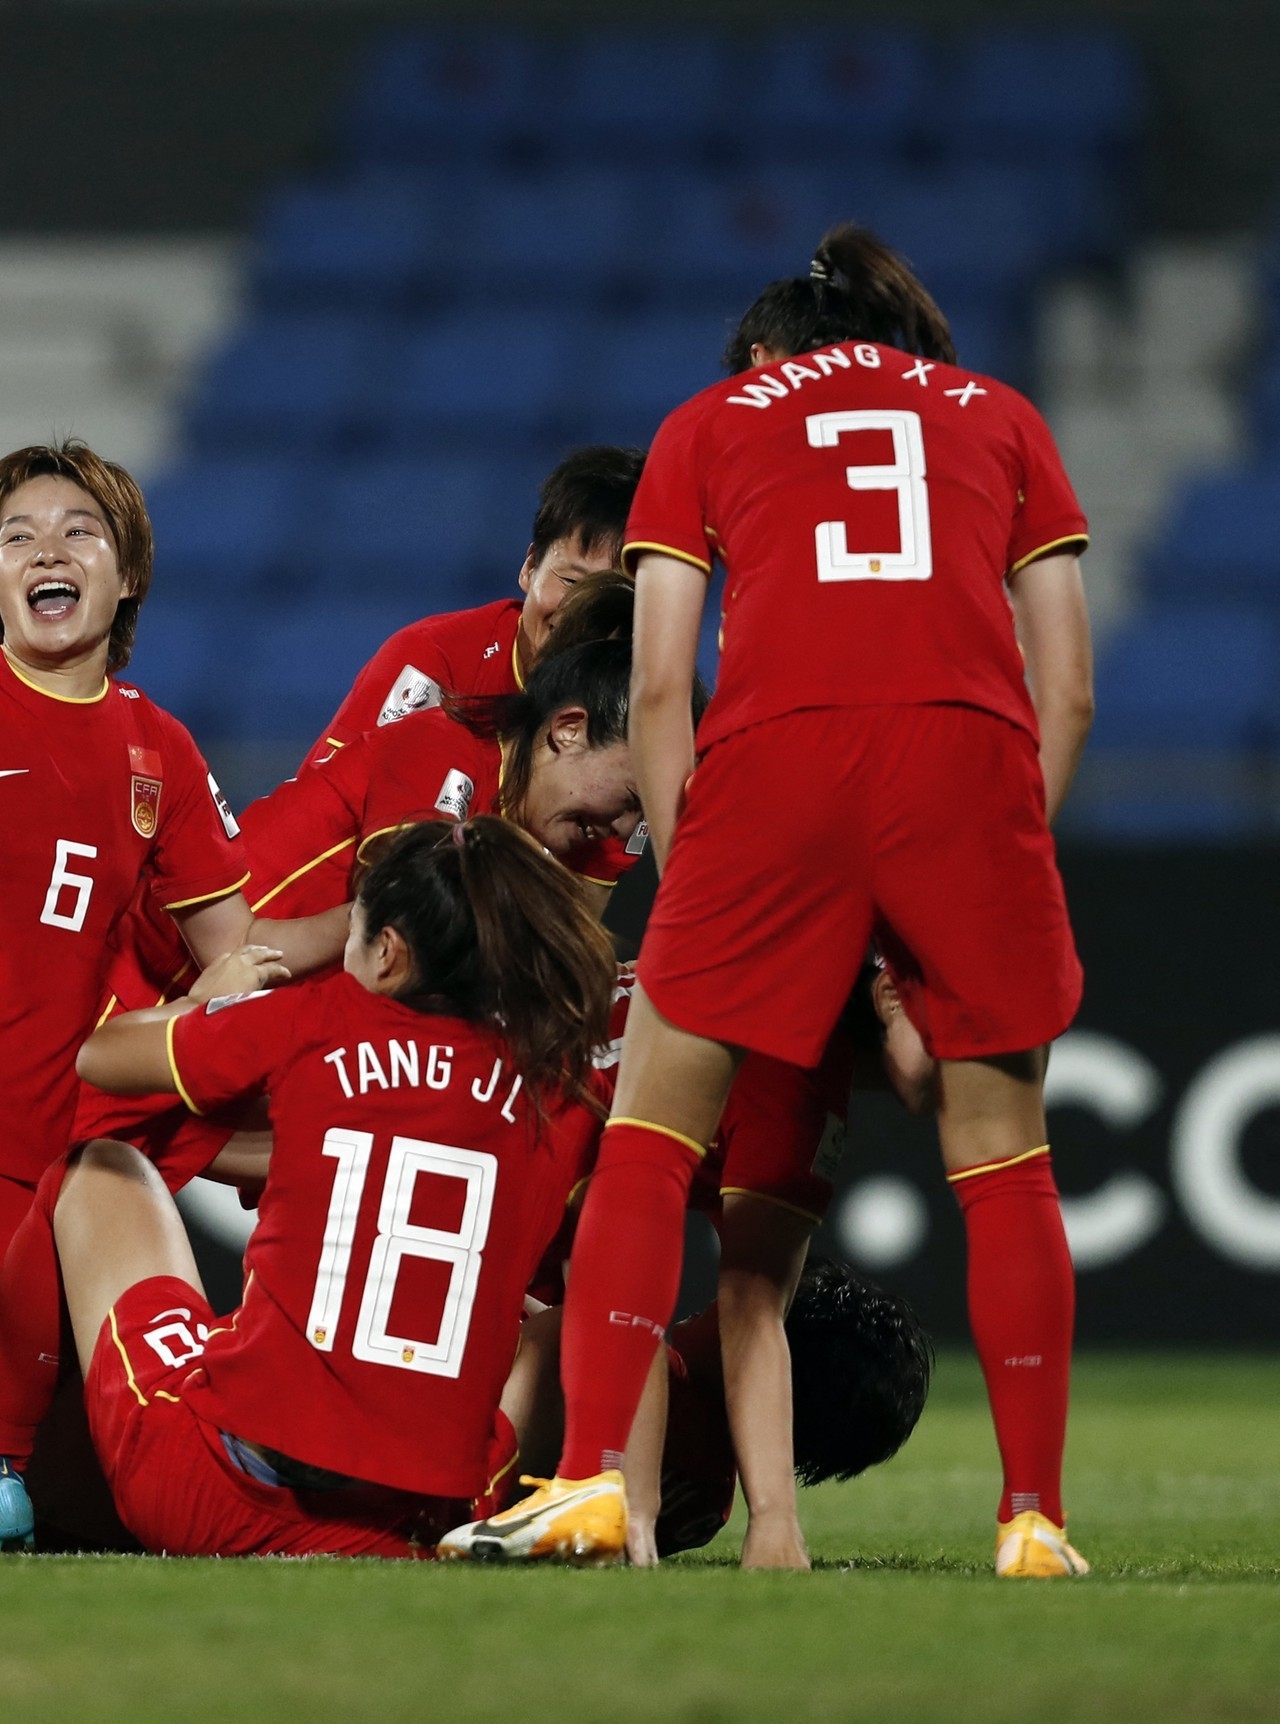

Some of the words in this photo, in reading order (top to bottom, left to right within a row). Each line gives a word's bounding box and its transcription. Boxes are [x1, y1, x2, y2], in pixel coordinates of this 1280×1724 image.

[726, 344, 882, 409] WANG
[805, 409, 933, 583] 3
[135, 781, 158, 796] CFA
[40, 838, 98, 933] 6
[323, 1039, 455, 1099] TANG
[305, 1127, 499, 1379] 18
